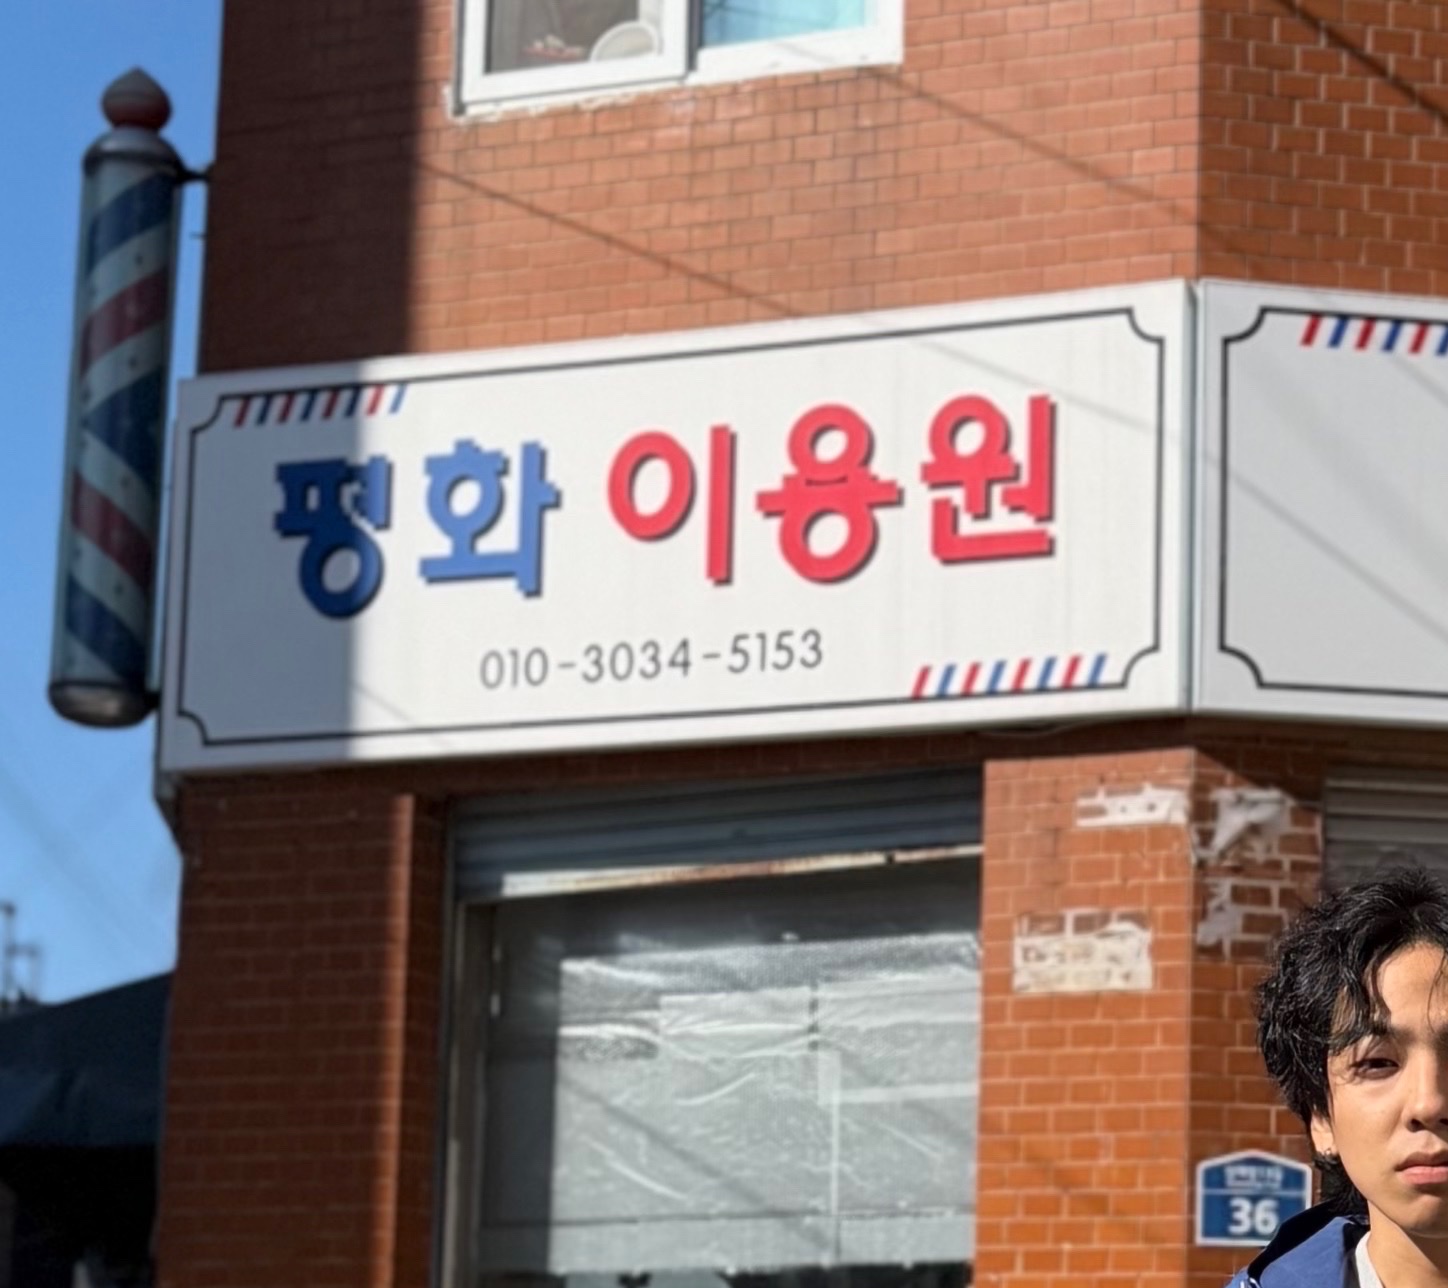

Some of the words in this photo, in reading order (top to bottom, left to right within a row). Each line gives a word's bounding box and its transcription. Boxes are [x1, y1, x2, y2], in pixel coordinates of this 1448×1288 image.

[272, 438, 562, 619] 평화
[606, 394, 1056, 584] 이용원
[479, 628, 823, 690] 010-3034-5153
[1228, 1196, 1279, 1236] 36
